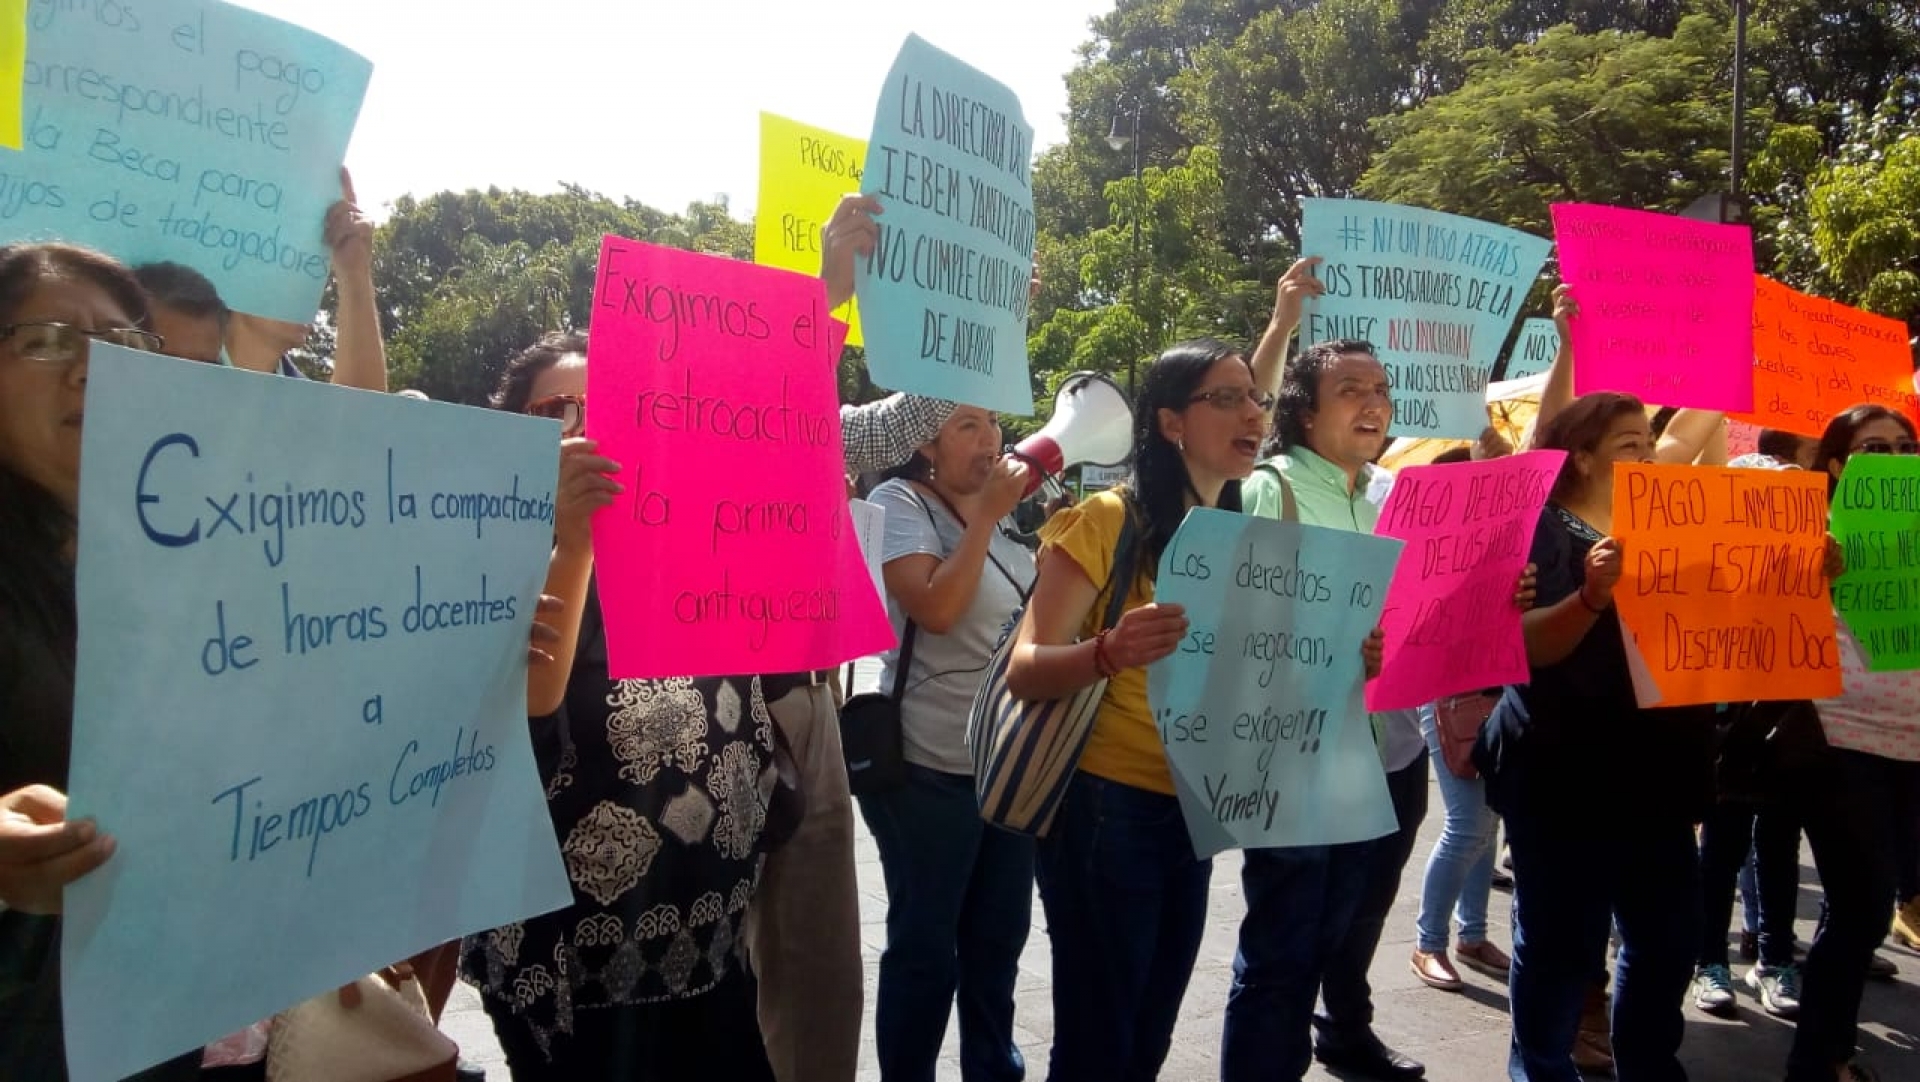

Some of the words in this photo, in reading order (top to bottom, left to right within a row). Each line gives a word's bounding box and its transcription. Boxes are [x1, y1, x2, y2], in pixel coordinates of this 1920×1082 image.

[171, 12, 205, 54] el
[237, 48, 324, 116] pago
[900, 74, 924, 140] LA
[88, 127, 181, 182] Beca
[193, 169, 283, 214] para
[800, 136, 846, 177] PAGOS
[88, 191, 139, 228] de
[1373, 216, 1394, 253] NI
[1400, 219, 1421, 257] UN
[866, 222, 907, 283] NO
[912, 234, 976, 301] CUMPLE
[600, 247, 770, 362] Exigimos
[793, 299, 817, 350] el
[1466, 277, 1490, 312] DE
[1489, 284, 1514, 319] LA
[921, 307, 949, 363] DE
[1388, 317, 1412, 351] NO
[1523, 333, 1546, 361] NO
[1405, 363, 1423, 392] NO
[635, 369, 832, 448] retroactivo
[136, 433, 366, 567] Exigimos
[386, 447, 417, 524] la
[633, 463, 670, 527] la
[713, 499, 809, 555] prima
[1387, 476, 1453, 531] PAGO
[1628, 471, 1707, 531] PAGO
[1843, 477, 1876, 510] LOS
[1169, 534, 1211, 580] Los
[1235, 542, 1332, 603] derechos
[1350, 581, 1373, 608] no
[1421, 535, 1453, 580] DE
[1636, 547, 1690, 597] DEL
[1846, 531, 1867, 572] NO
[1869, 530, 1894, 571] SE
[202, 600, 259, 675] de
[282, 582, 387, 655] horas
[403, 565, 517, 633] docentes
[1181, 631, 1215, 655] se
[363, 694, 384, 725] a
[212, 776, 371, 877] Tiempos
[389, 726, 496, 808] Completos
[1203, 771, 1281, 832] Yanely
